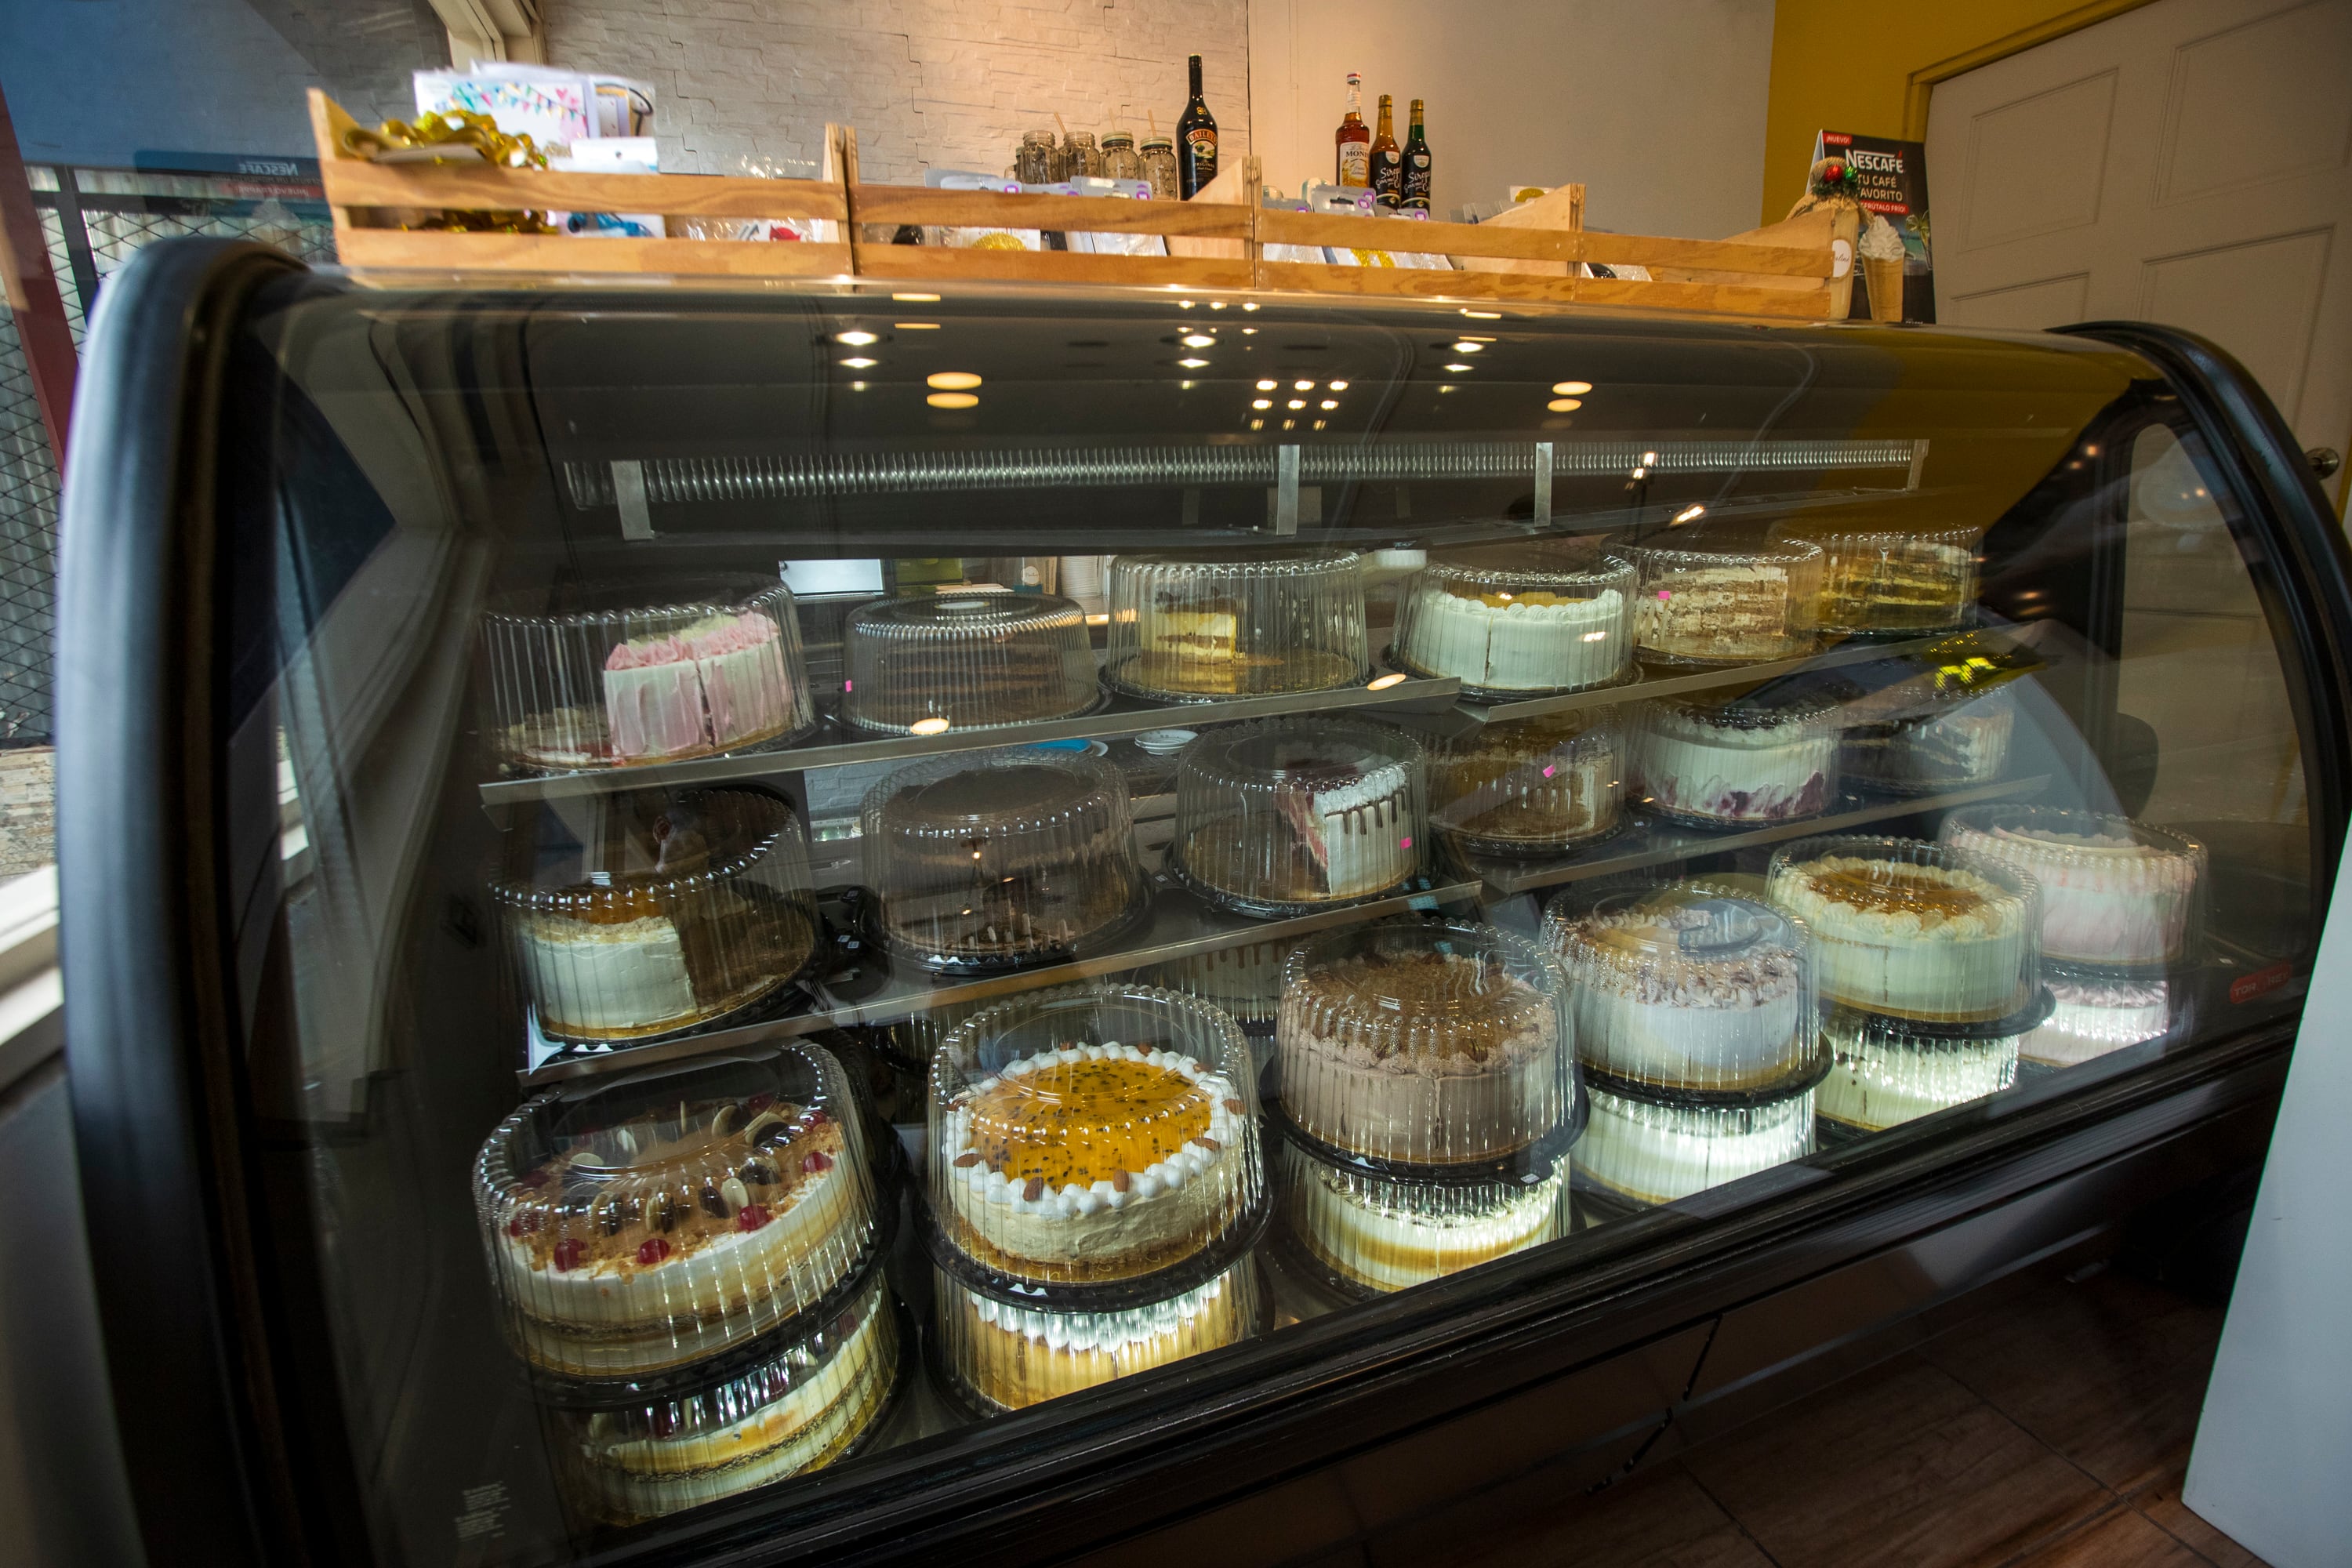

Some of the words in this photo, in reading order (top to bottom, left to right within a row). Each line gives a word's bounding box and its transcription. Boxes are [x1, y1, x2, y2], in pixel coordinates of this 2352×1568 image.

[1846, 149, 1904, 172] NESCAFÉ
[1858, 174, 1869, 185] TU
[1872, 175, 1896, 187] CAFÉ
[1858, 188, 1903, 201] AVORITO
